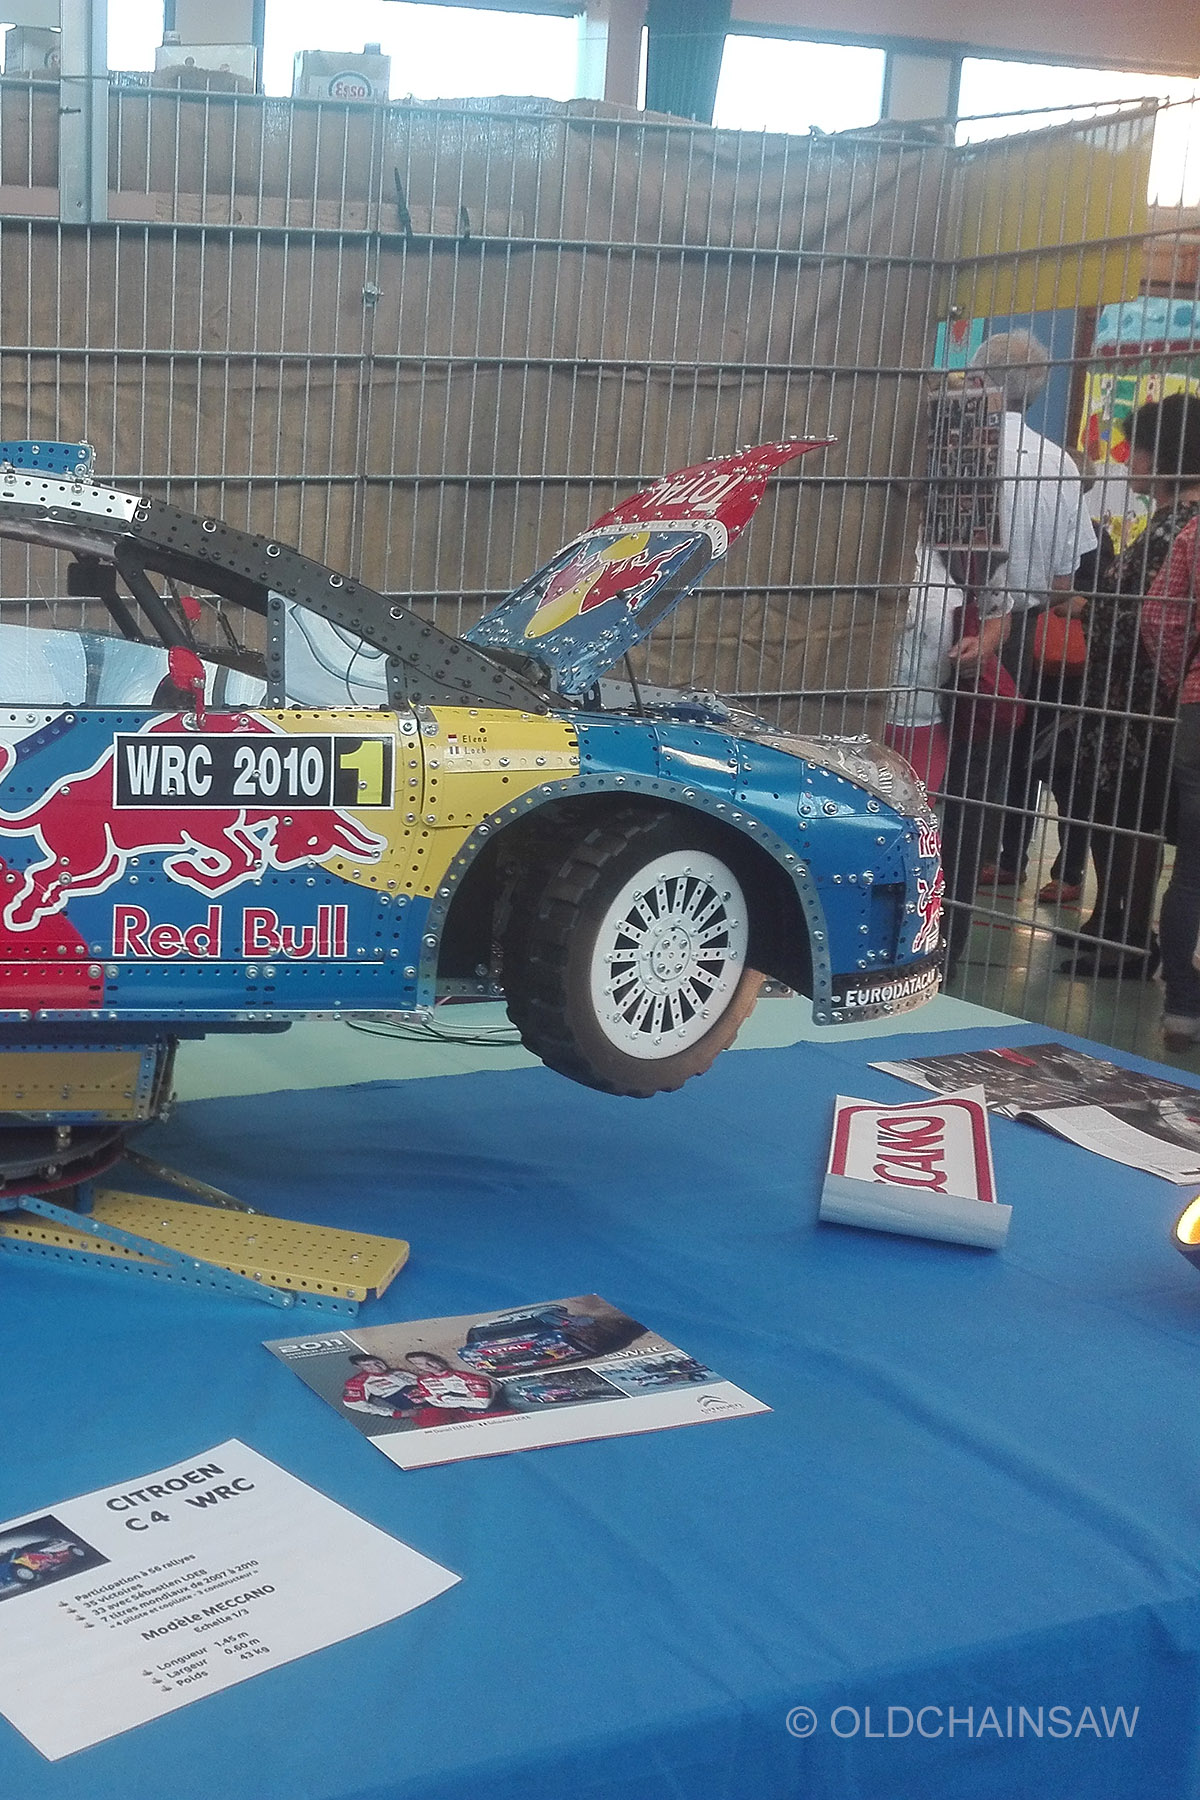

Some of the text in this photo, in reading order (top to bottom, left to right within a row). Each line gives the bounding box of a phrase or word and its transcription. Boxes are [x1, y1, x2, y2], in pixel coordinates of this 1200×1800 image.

[642, 474, 745, 511] TOTAL
[462, 734, 488, 743] Elena
[126, 740, 383, 804] WRC 2010 1
[112, 904, 348, 958] Red Bull
[278, 1338, 344, 1354] 2011
[106, 1463, 225, 1512] CITROEN
[184, 1477, 255, 1509] WRC
[74, 1573, 141, 1602] Participation
[163, 1554, 196, 1569] rallyes
[107, 1598, 132, 1611] avec
[131, 1578, 181, 1601] Sébastien
[109, 1605, 139, 1620] titres
[139, 1586, 190, 1609] mondiaux
[190, 1580, 204, 1589] de
[203, 1571, 228, 1584] 2007
[234, 1559, 259, 1572] 2010
[83, 1583, 144, 1609] 35 victoires
[141, 1584, 276, 1641] Modèle MECCANO
[193, 1608, 249, 1634] Echelle 1/3
[156, 1646, 209, 1671] Longueur
[166, 1658, 209, 1680] Largeur
[175, 1645, 271, 1687] Poids 43 kg
